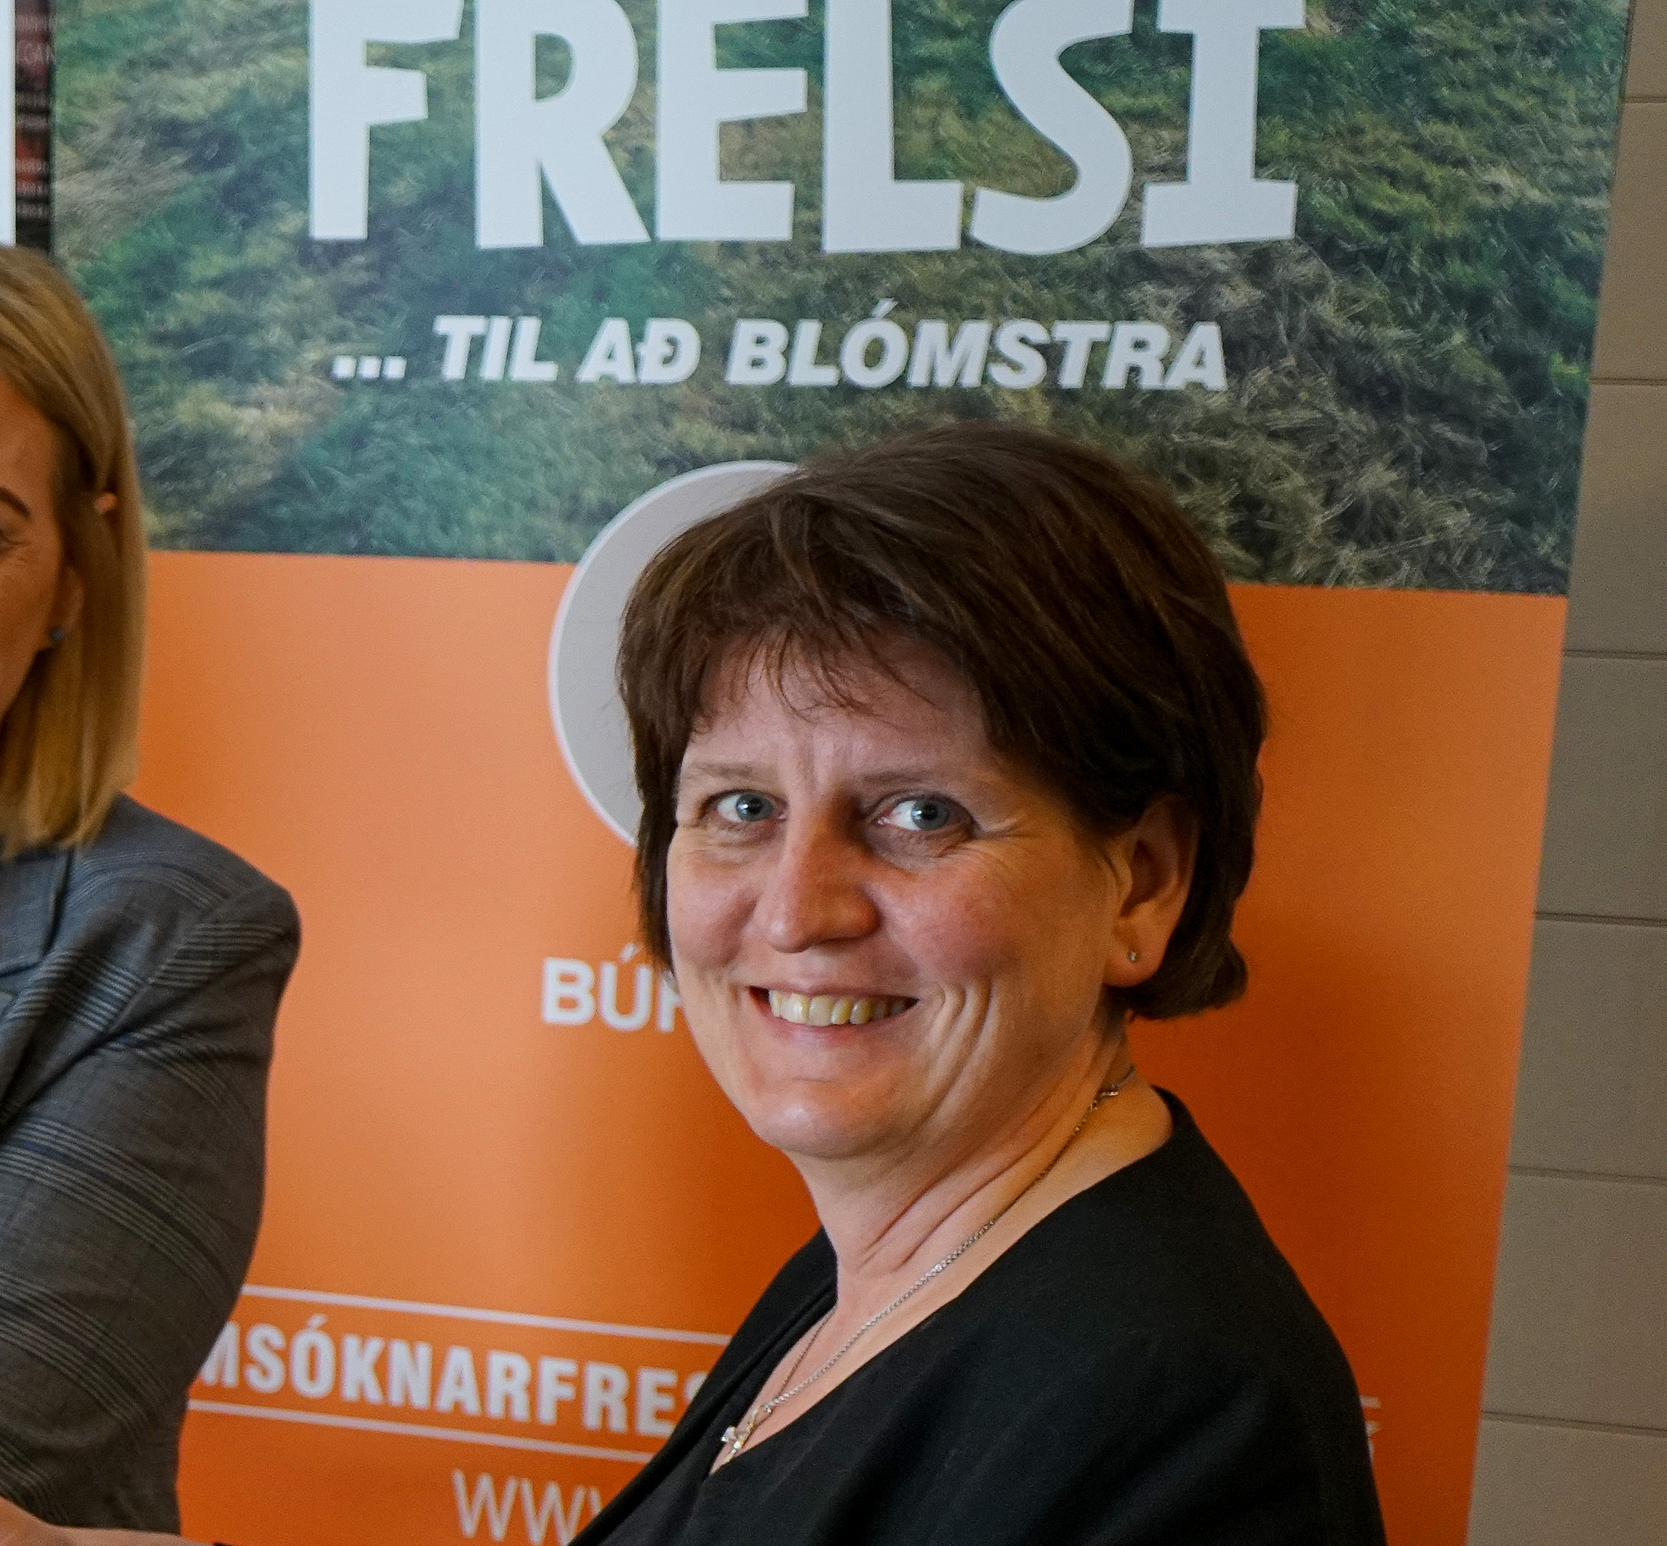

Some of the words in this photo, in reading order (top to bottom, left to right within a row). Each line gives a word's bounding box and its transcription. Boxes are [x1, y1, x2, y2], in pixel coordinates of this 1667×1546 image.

[307, 0, 1305, 255] FRELSI
[432, 313, 559, 383] TIL
[576, 316, 702, 386] AÐ
[725, 298, 1229, 392] BLÓMSTRA
